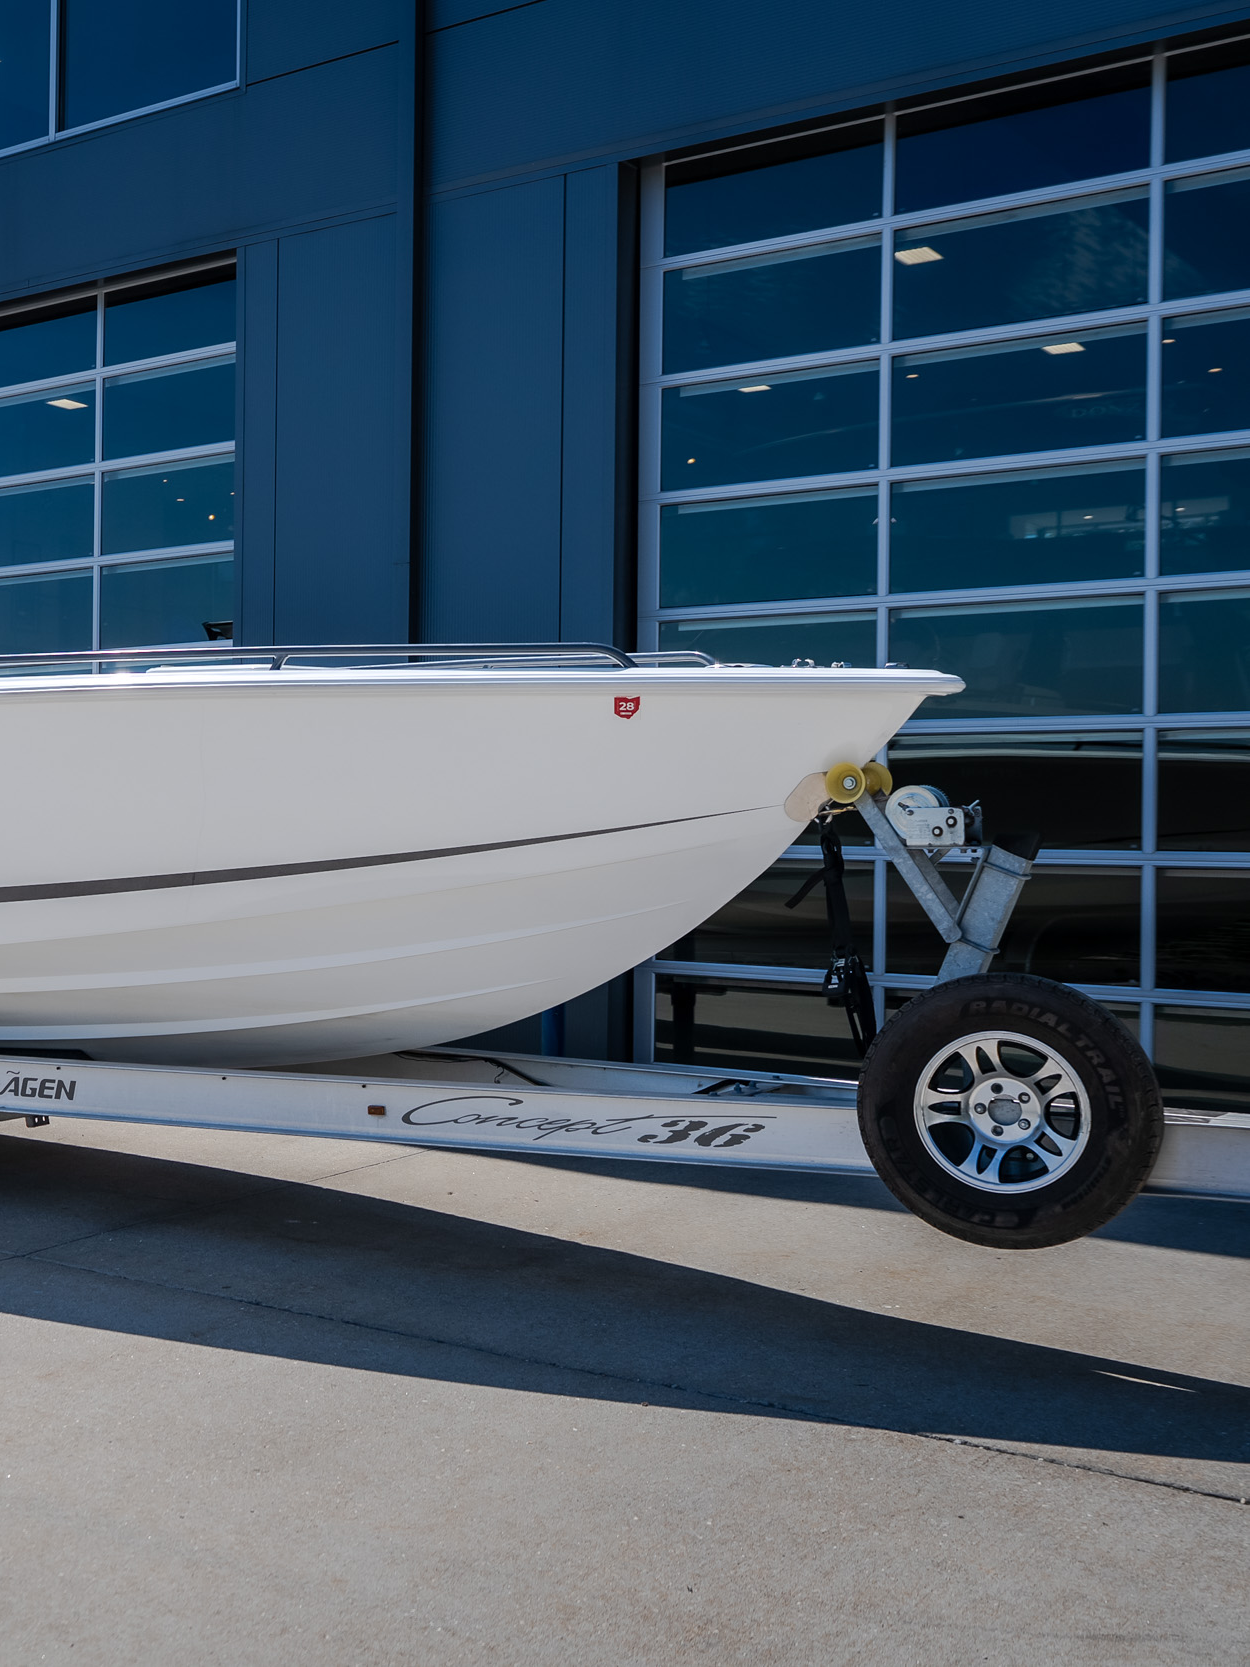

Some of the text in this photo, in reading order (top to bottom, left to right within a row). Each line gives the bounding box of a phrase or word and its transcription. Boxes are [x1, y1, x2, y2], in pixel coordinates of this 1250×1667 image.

[618, 701, 635, 711] 28
[969, 1000, 1124, 1109] RADIAL TRAIL
[401, 1095, 777, 1148] Concept 36
